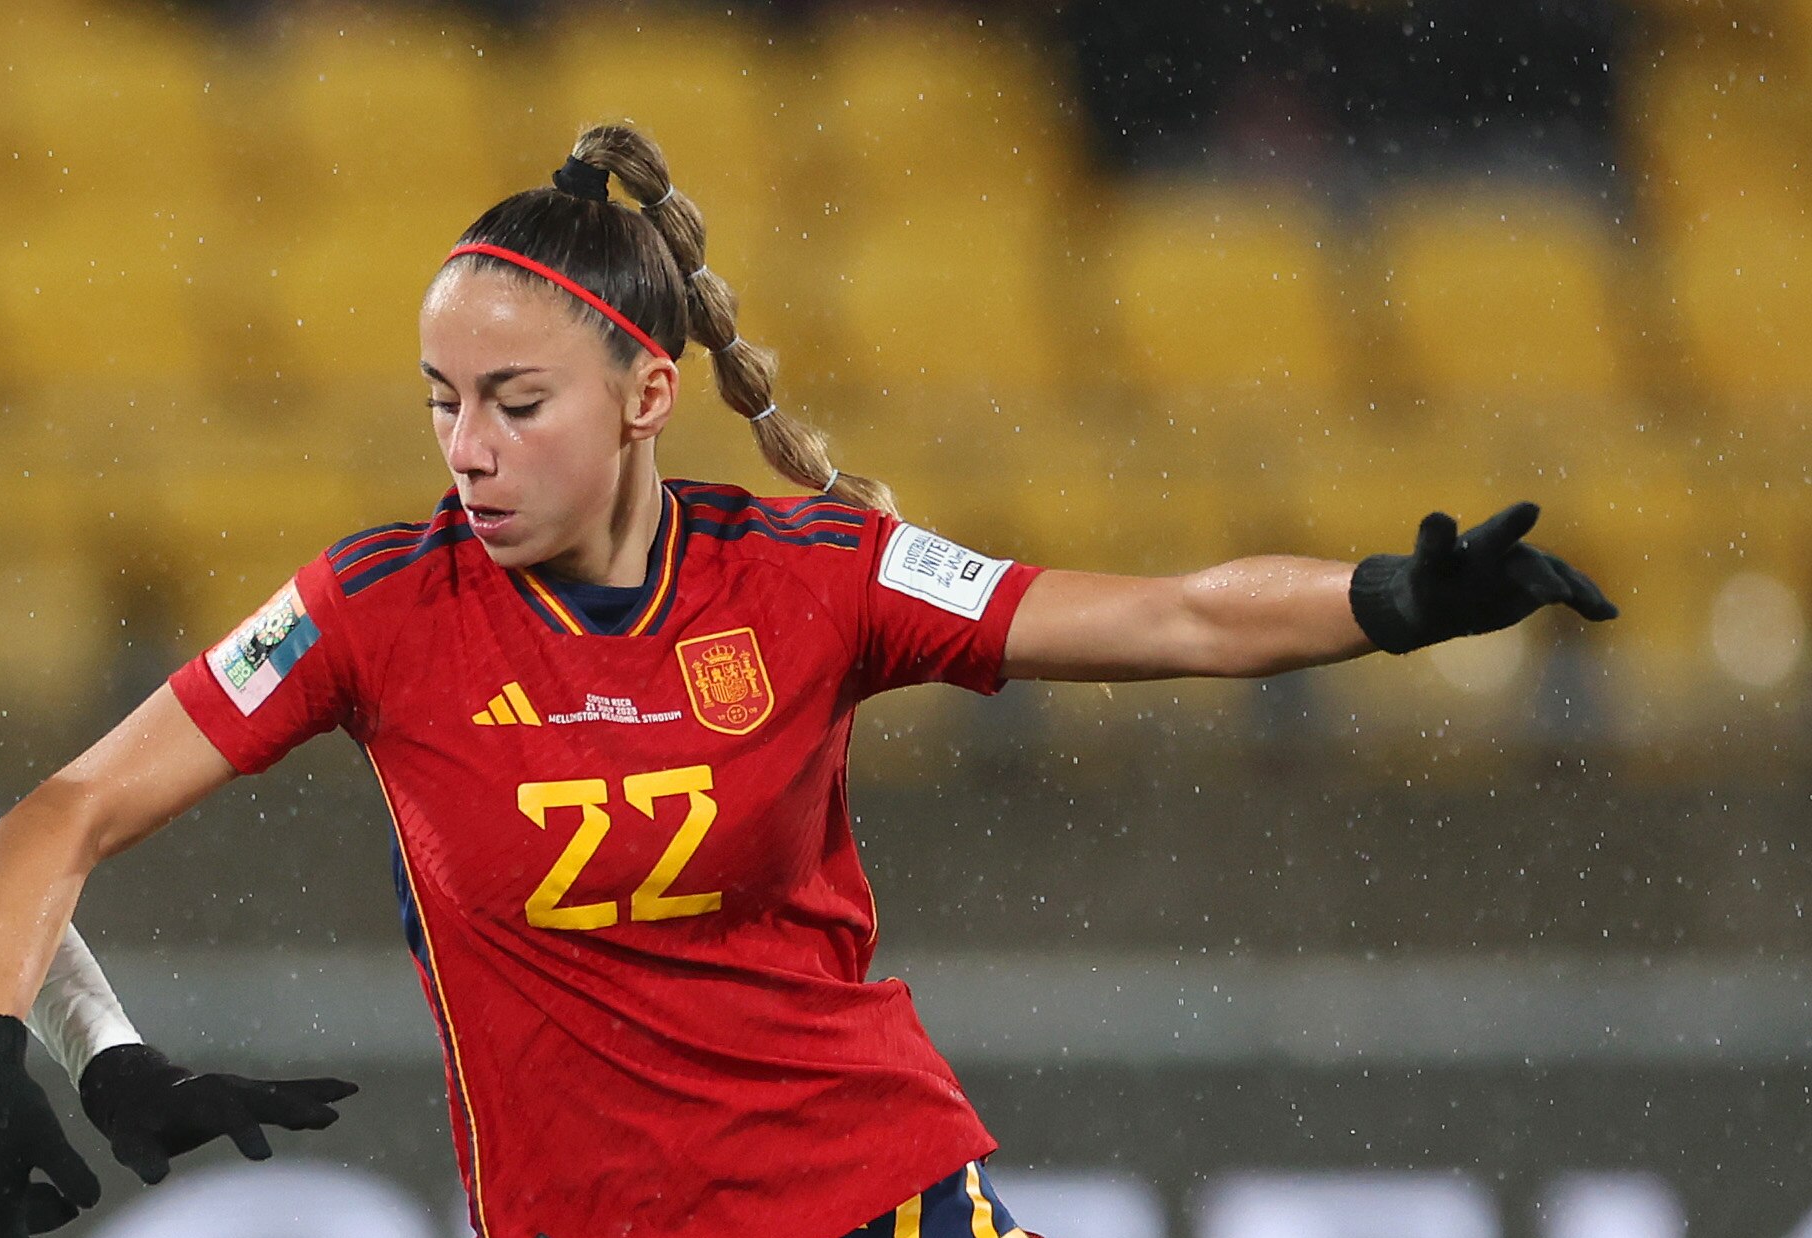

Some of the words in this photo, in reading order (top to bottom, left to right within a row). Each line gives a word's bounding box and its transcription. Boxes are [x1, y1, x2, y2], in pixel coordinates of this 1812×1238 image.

[548, 711, 600, 724] WELLINGTON
[641, 711, 682, 724] STADIUM
[517, 764, 723, 930] 22
